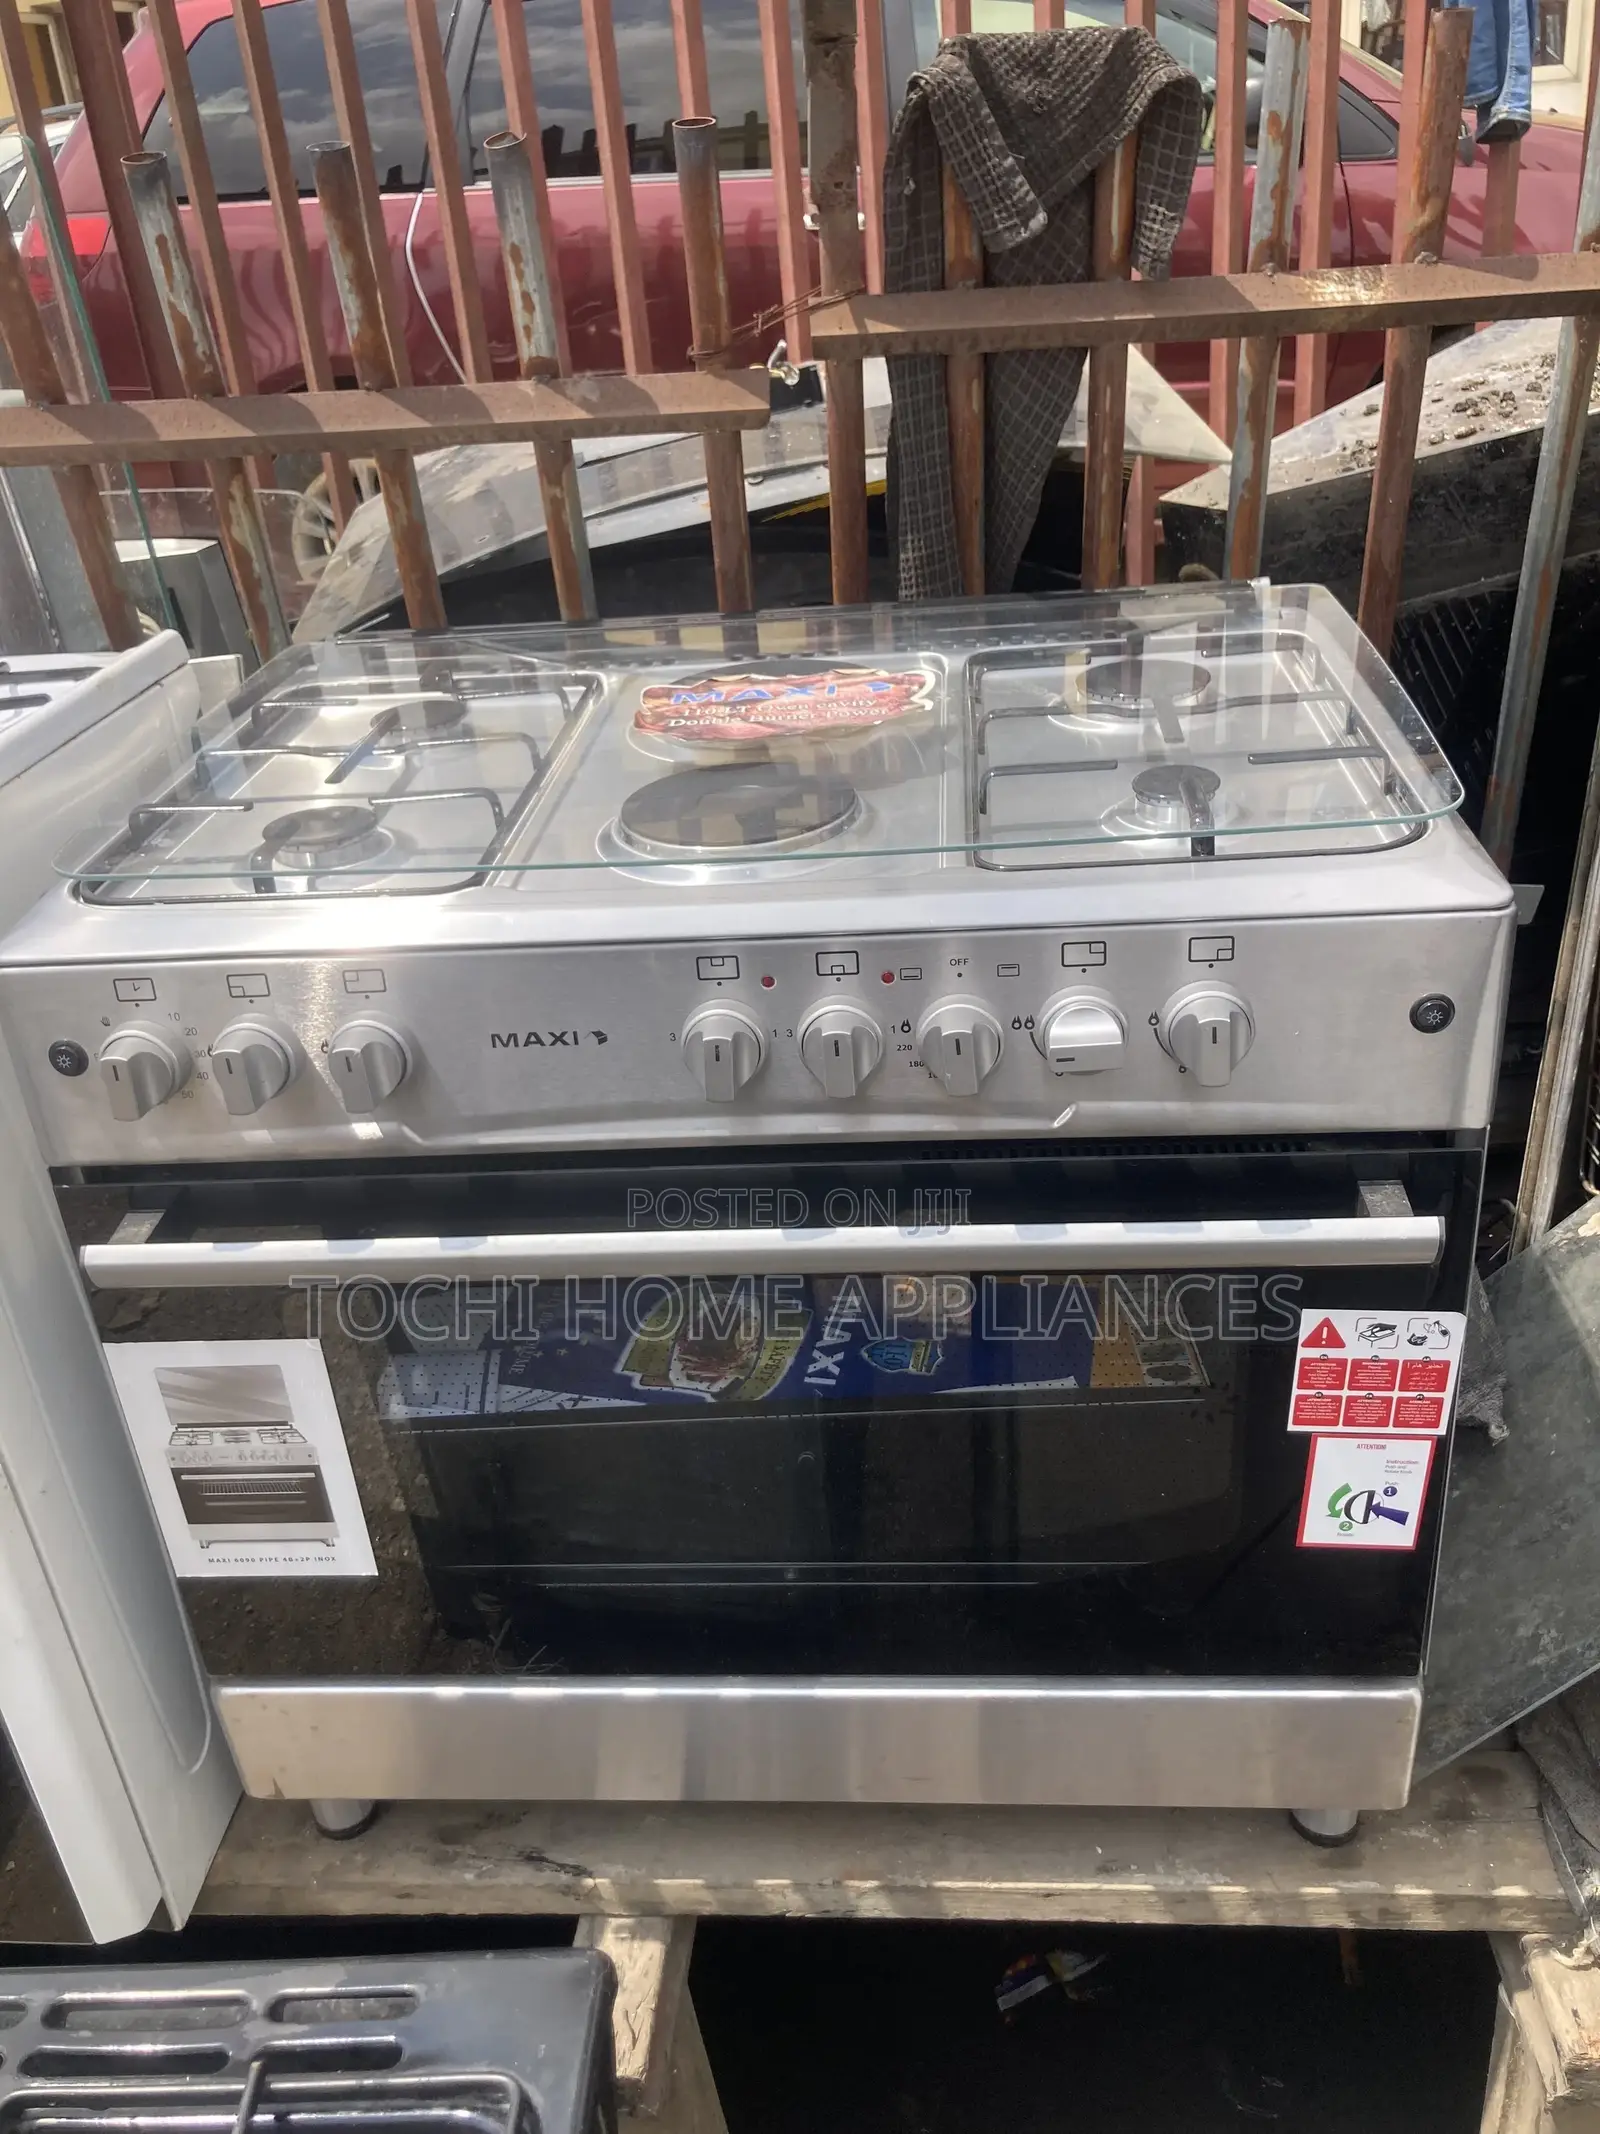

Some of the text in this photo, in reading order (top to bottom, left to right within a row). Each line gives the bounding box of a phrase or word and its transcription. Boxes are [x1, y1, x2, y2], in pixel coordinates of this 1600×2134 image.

[670, 683, 838, 705] MAXI
[669, 714, 743, 726] Double
[950, 957, 969, 967] OFF
[168, 1012, 181, 1022] 10
[184, 1027, 198, 1036] 20
[786, 1028, 793, 1038] 3
[490, 1030, 580, 1048] MAXI
[669, 1032, 677, 1042] 3
[896, 1044, 913, 1052] 220
[194, 1049, 207, 1059] 30
[909, 1060, 925, 1068] 180
[196, 1071, 209, 1081] 40
[181, 1089, 195, 1099] 50
